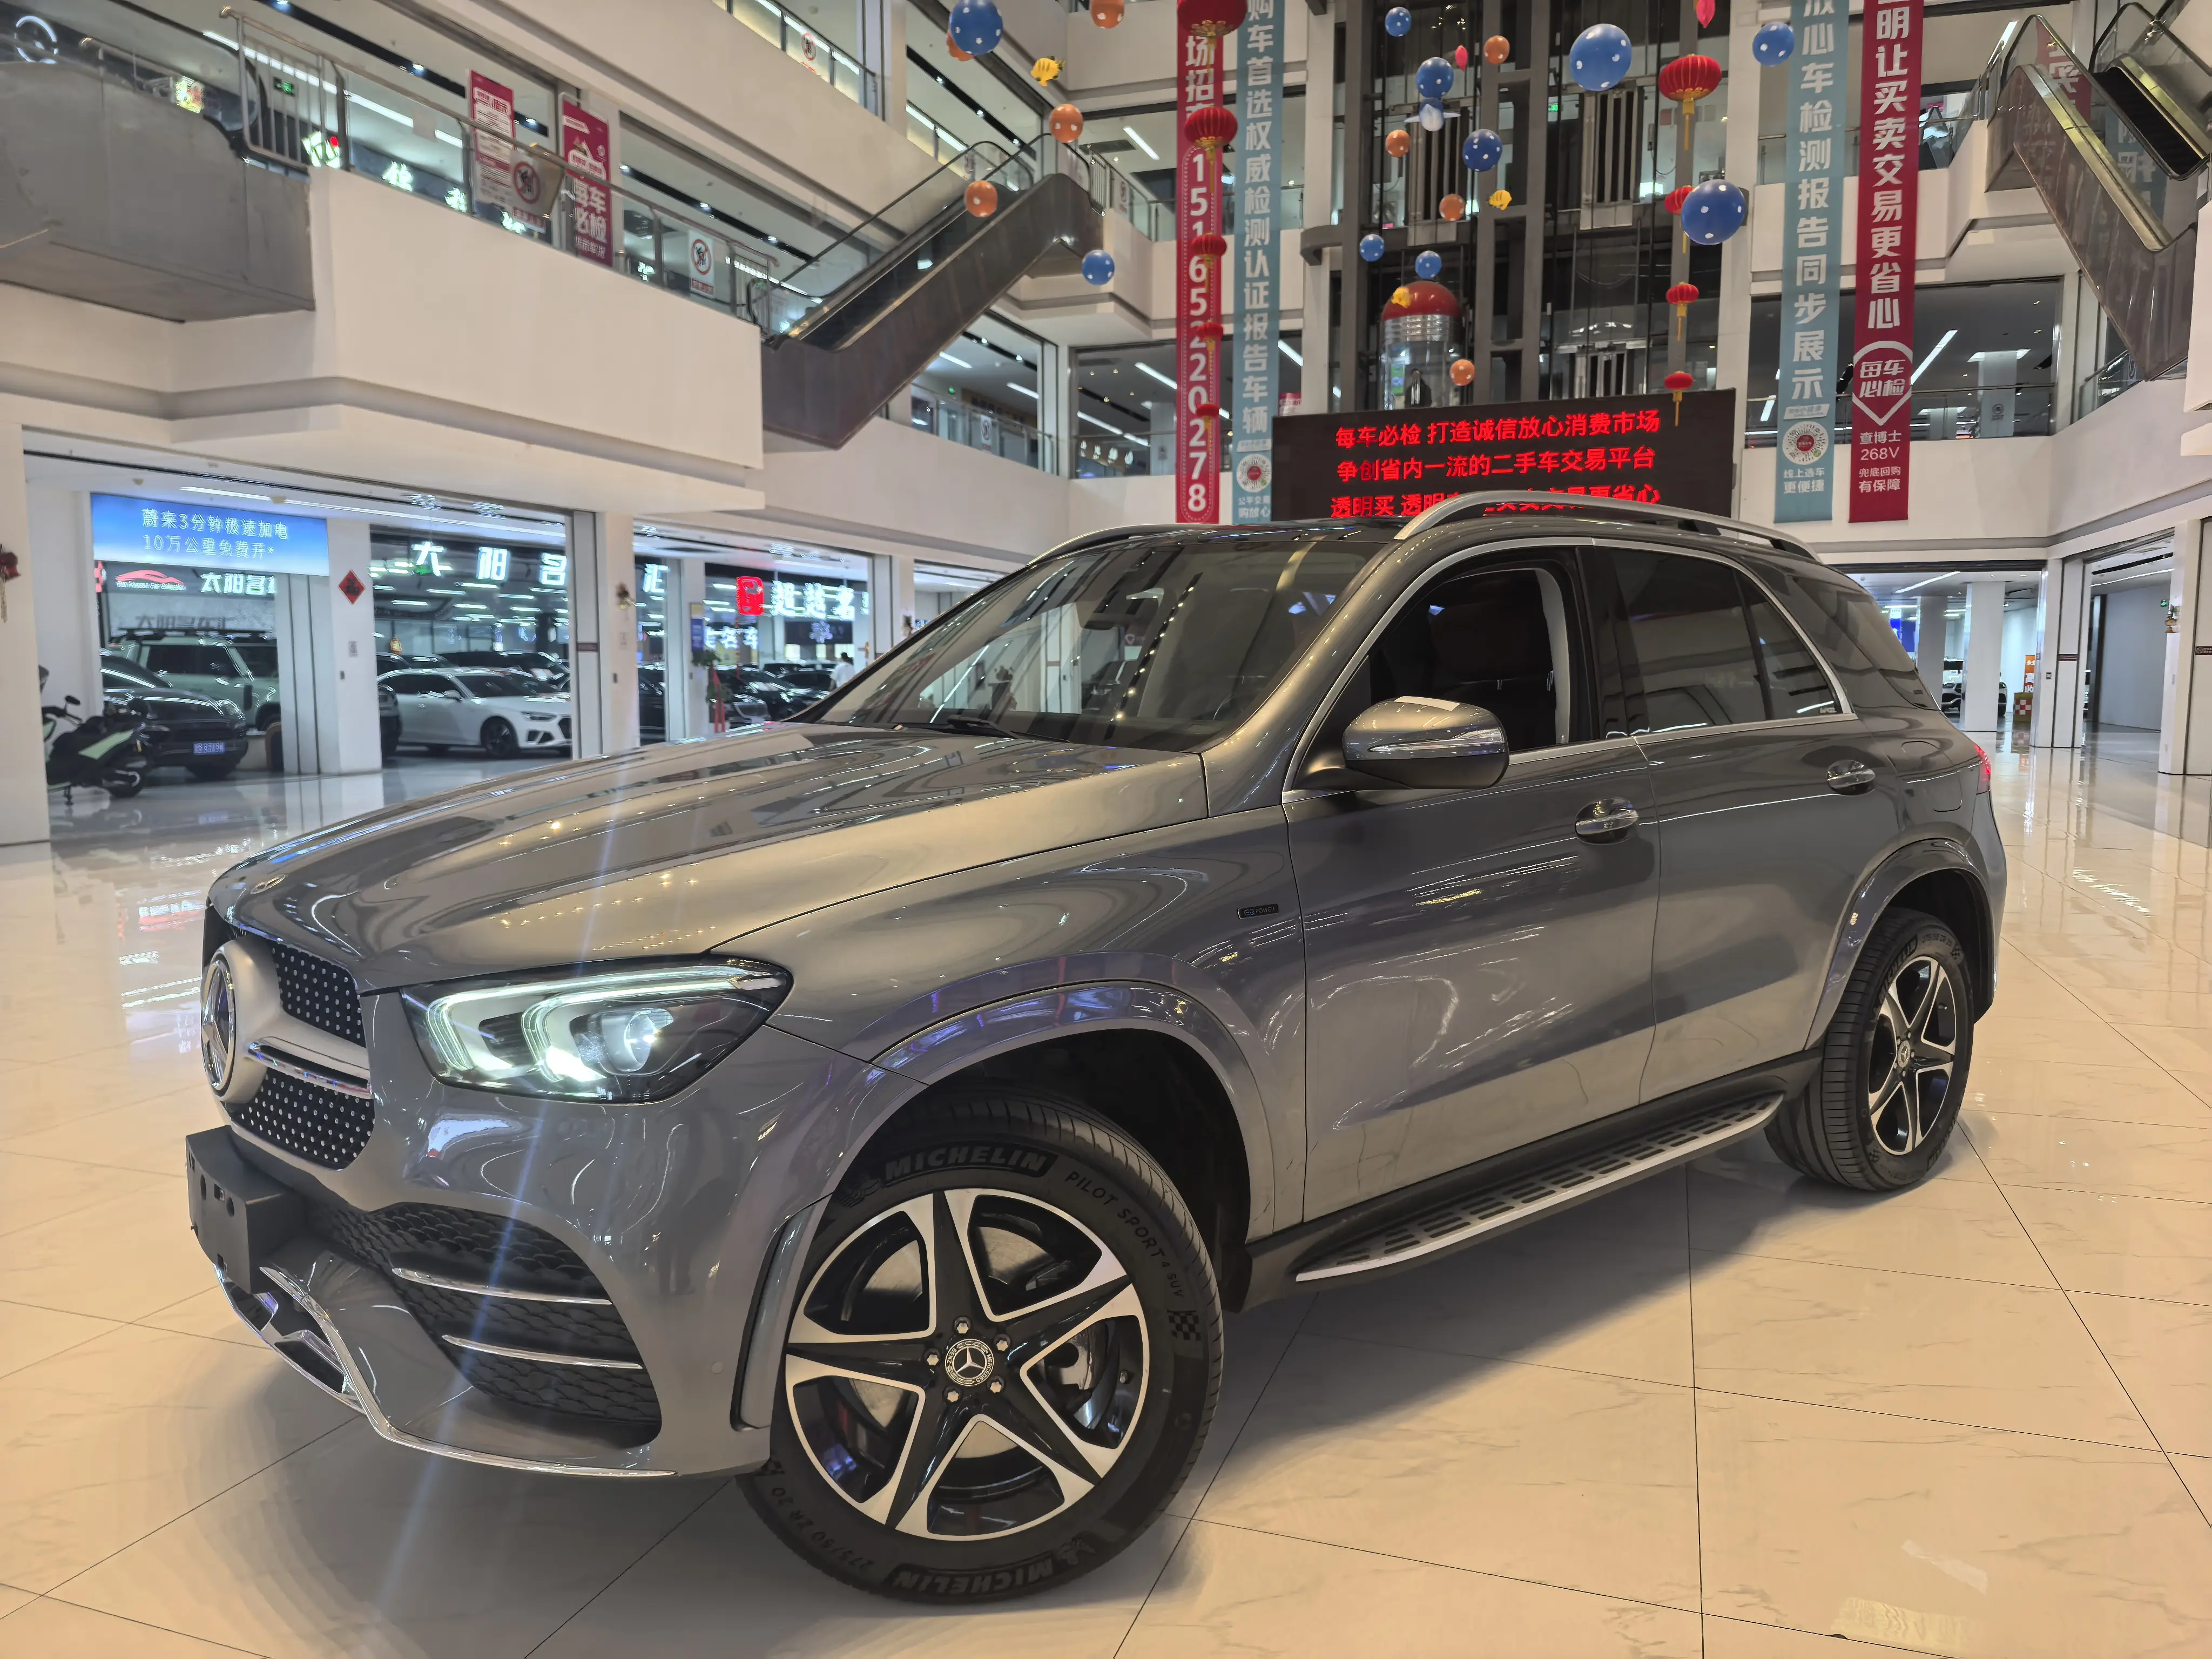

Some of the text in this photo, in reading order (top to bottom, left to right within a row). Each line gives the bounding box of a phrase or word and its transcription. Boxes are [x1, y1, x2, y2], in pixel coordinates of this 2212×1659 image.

[1867, 0, 1910, 329] 明让买卖交易更省心
[1243, 0, 1274, 434] 购车首选权威检测认证报告车辆
[1860, 360, 1906, 378] 每车
[1859, 379, 1905, 398] 必检
[1335, 409, 1661, 449] 每车必检 打造诚信放心消费市场
[1860, 430, 1902, 444] 查博士
[1337, 445, 1656, 482] 争创省内一流的二手车交易平台
[1860, 446, 1900, 461] 268V
[1783, 467, 1825, 478] 线上选车
[1859, 466, 1901, 477] 兜底回购
[1783, 480, 1824, 494] 更便捷
[1859, 478, 1901, 493] 有保障
[1330, 495, 1395, 518] 透明买
[1400, 491, 1460, 517] 透明
[141, 508, 288, 539] 蔚来3分钟极速加电
[1256, 906, 1275, 914] POWER
[885, 1145, 1047, 1181] MICHELIN
[1064, 1171, 1118, 1208] PILOT
[1117, 1208, 1166, 1259] SPORT
[1166, 1272, 1185, 1298] SUV
[947, 1347, 957, 1365] BENZ
[975, 1353, 992, 1384] MERCEDES
[893, 1559, 1054, 1596] MICHELIN
